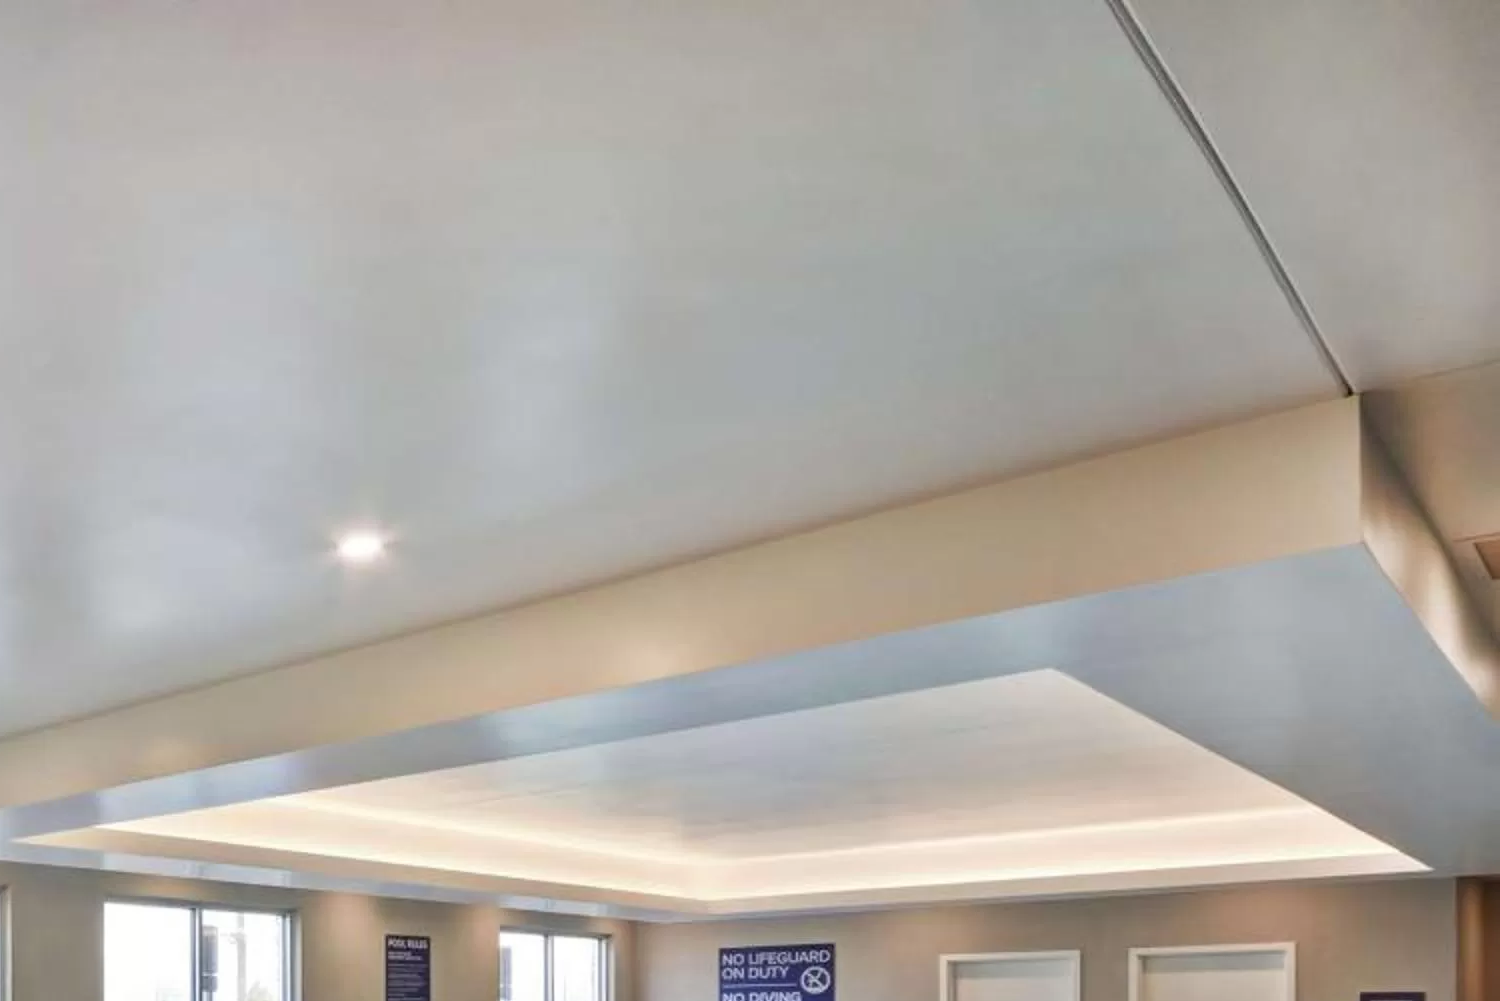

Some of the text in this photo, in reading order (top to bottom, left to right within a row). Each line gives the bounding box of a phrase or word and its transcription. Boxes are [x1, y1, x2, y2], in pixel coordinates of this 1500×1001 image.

[722, 950, 830, 966] NO LIFEGUARD
[722, 966, 789, 980] ON DUTY
